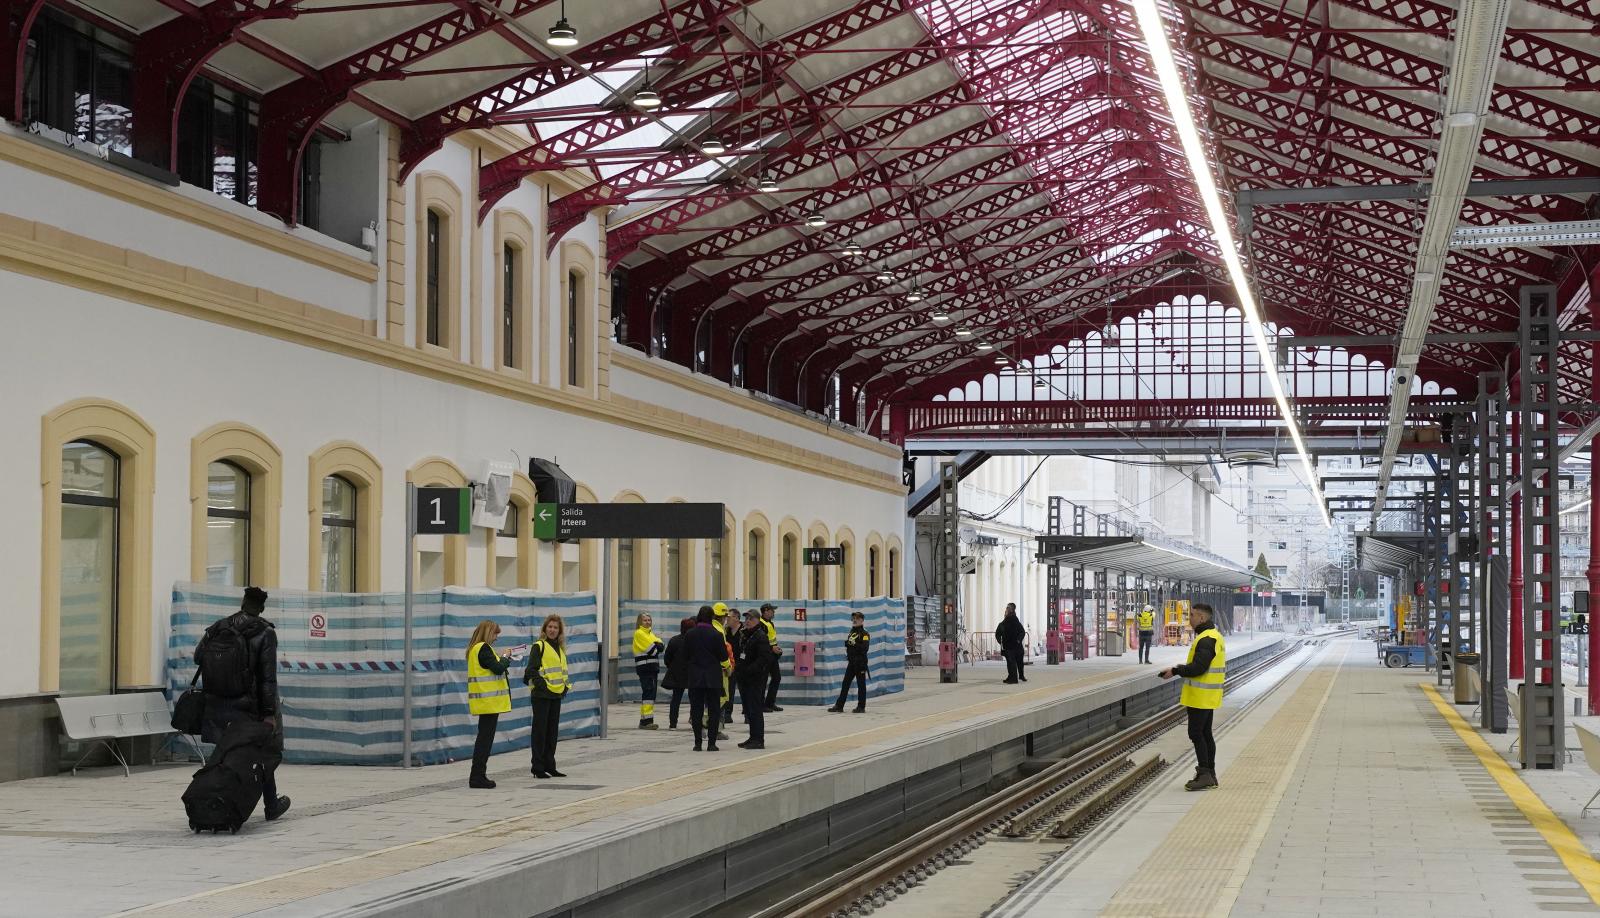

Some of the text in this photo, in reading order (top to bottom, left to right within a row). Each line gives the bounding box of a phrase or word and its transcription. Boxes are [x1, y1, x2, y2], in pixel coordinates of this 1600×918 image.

[430, 497, 446, 525] 1
[561, 508, 583, 516] Salida
[561, 518, 587, 526] Irteera
